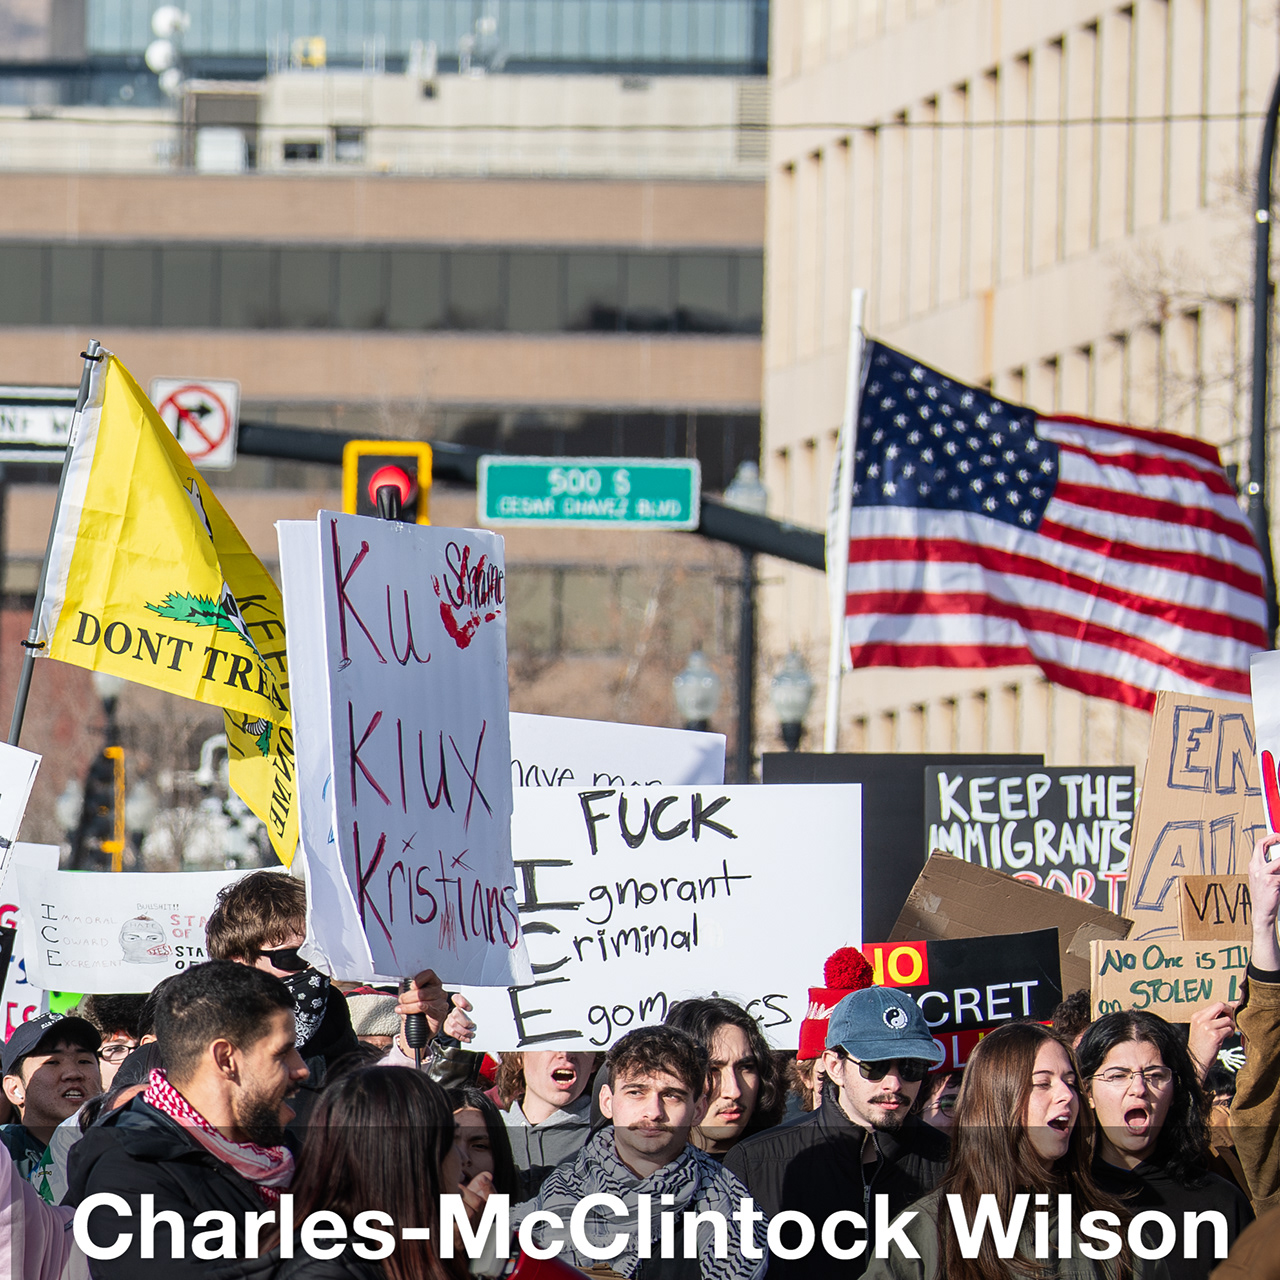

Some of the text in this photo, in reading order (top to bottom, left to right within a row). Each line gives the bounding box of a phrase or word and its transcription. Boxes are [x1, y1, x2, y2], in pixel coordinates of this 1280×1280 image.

[548, 467, 630, 497] 500 S
[563, 497, 629, 518] CHAVEZ
[635, 499, 682, 518] BLVD
[331, 518, 431, 669] Ku
[72, 611, 193, 671] DONT
[202, 647, 288, 711] TREA
[578, 789, 738, 855] FUCK
[938, 772, 1133, 823] KEEP THE
[929, 819, 1131, 871] IMMIGRANTS
[1196, 950, 1215, 970] is
[1129, 977, 1212, 1010] STOLEN
